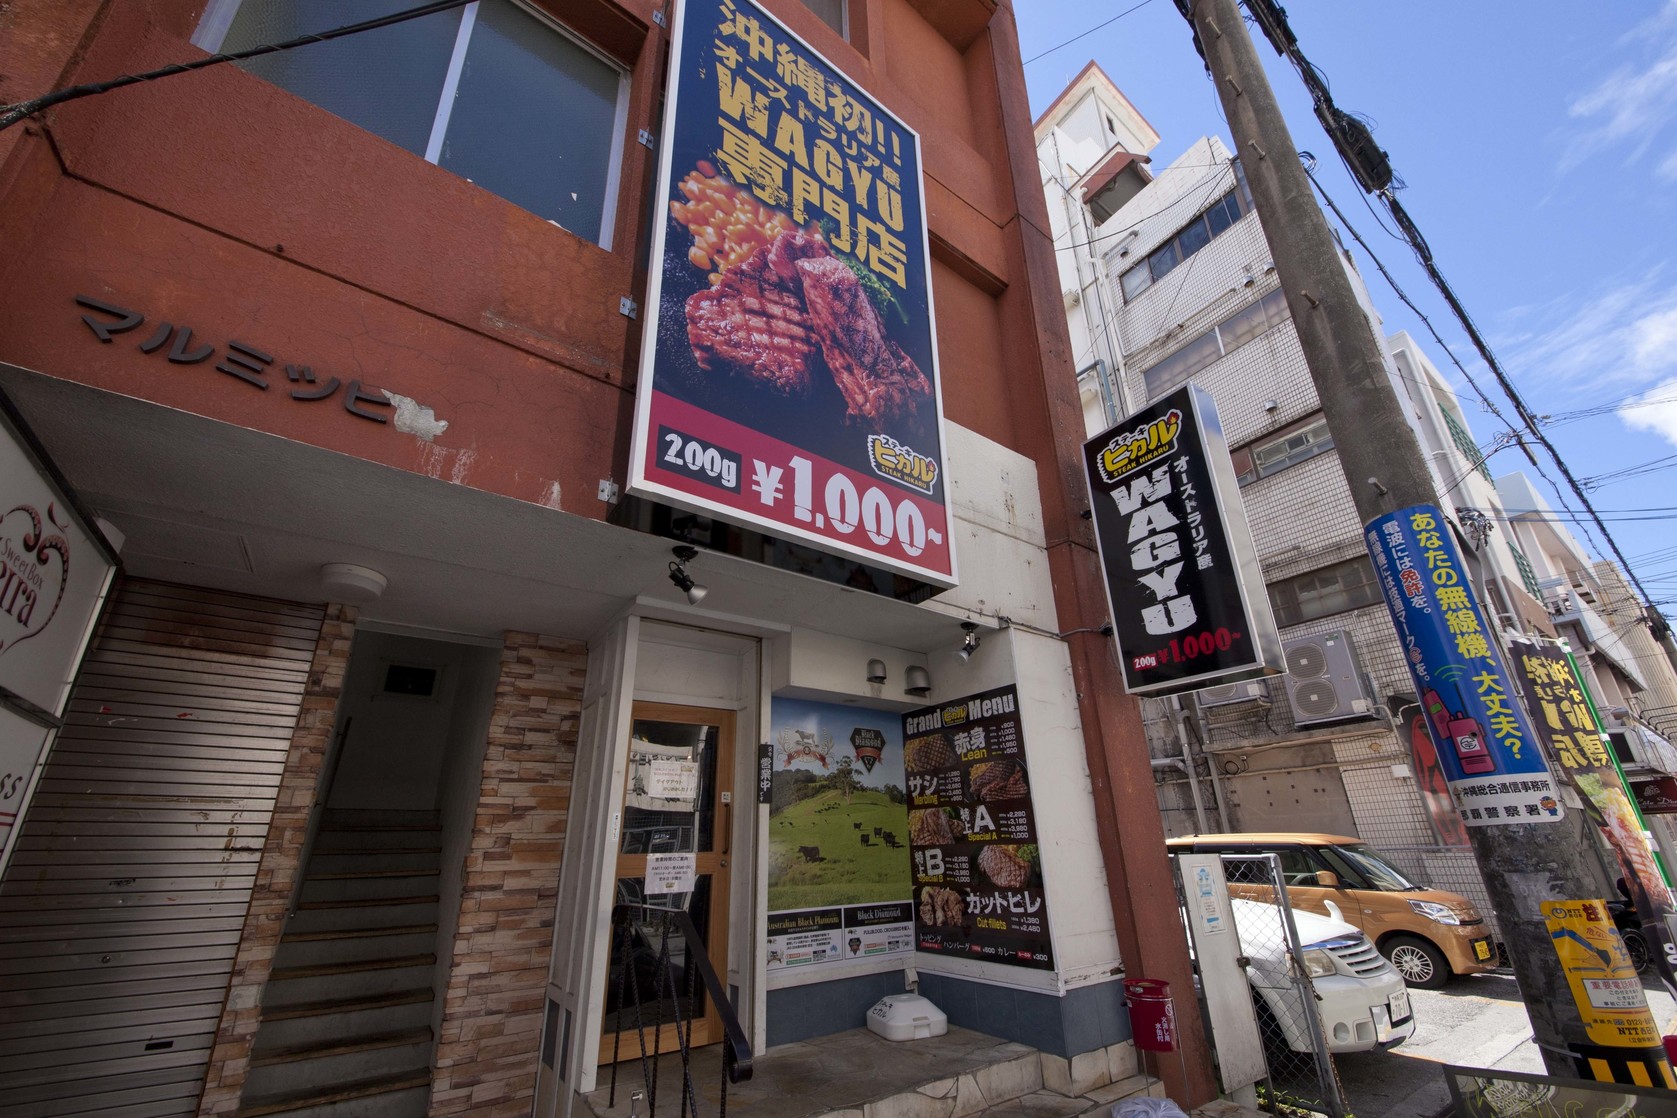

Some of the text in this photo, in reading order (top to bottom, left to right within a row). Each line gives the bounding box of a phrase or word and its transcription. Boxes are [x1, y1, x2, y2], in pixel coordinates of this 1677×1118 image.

[714, 39, 900, 190] オーストラリア産
[716, 62, 904, 232] WAGYU
[717, 117, 907, 290] 専門店
[882, 436, 913, 458] ステーキ
[1104, 420, 1178, 472] ヒカル
[1111, 427, 1147, 450] ステーキ
[664, 433, 736, 488] 200g
[874, 438, 935, 482] ヒカル
[1113, 445, 1169, 477] STEAK HIKARU
[881, 465, 927, 489] STEAK HIKARU
[1173, 455, 1214, 571] オーストラリア産
[1109, 460, 1197, 636] WAGYU
[27, 563, 44, 590] Box
[1382, 520, 1431, 614] 電波には免許を。
[1134, 654, 1157, 669] 200g
[906, 709, 941, 735] Grand
[968, 694, 1015, 720] Menu
[954, 726, 985, 755] 赤身
[961, 749, 987, 761] Lean
[760, 757, 772, 791] 営業中
[909, 775, 937, 798] サシ
[1462, 780, 1551, 797] 沖縄総合通信事務所
[960, 808, 972, 834] 特上
[974, 805, 996, 833] A
[1460, 804, 1541, 821] 那覇警察署
[968, 832, 997, 843] Special A
[925, 848, 945, 876] B
[798, 916, 813, 927] Black
[858, 907, 900, 920] Black Diamond
[977, 917, 988, 928] Cut
[988, 918, 1006, 930] fillets
[920, 933, 941, 943] トッピング
[944, 942, 970, 951] ハンバーグ
[998, 947, 1015, 956] カレー
